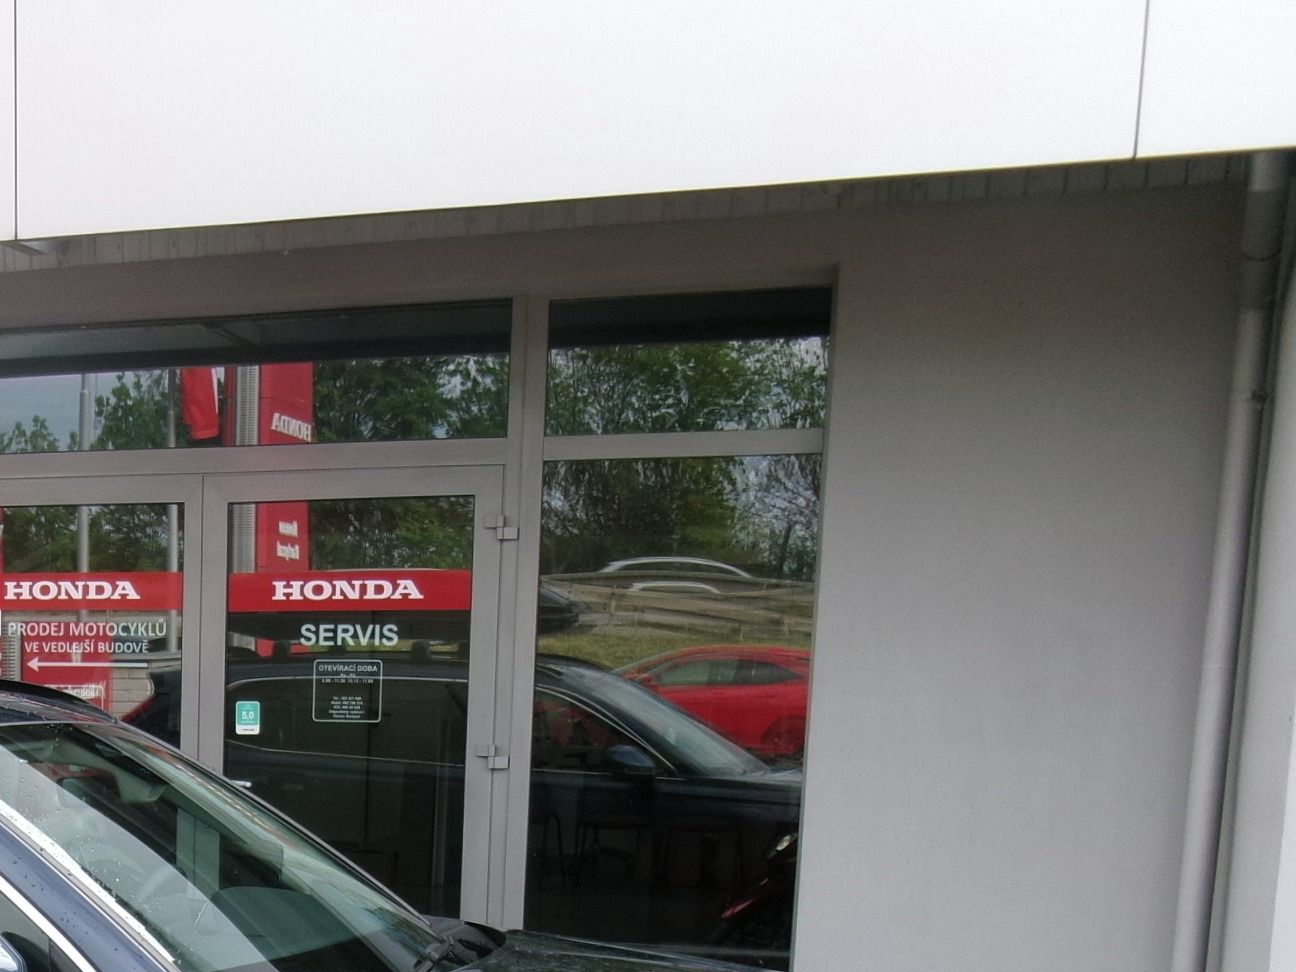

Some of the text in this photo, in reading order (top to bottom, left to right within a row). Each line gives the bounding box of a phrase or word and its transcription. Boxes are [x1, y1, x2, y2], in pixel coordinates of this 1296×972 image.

[4, 581, 141, 600] HONDA
[272, 579, 424, 600] HONDA
[7, 622, 65, 637] PRODEJ
[69, 617, 167, 637] MOTOCYKLŮ
[300, 623, 399, 647] SERVIS
[24, 638, 150, 653] VE VEDLEJŠÍ BUDOVĚ
[318, 664, 356, 672] OTEVÍRACÍ
[241, 711, 255, 721] 5,0
